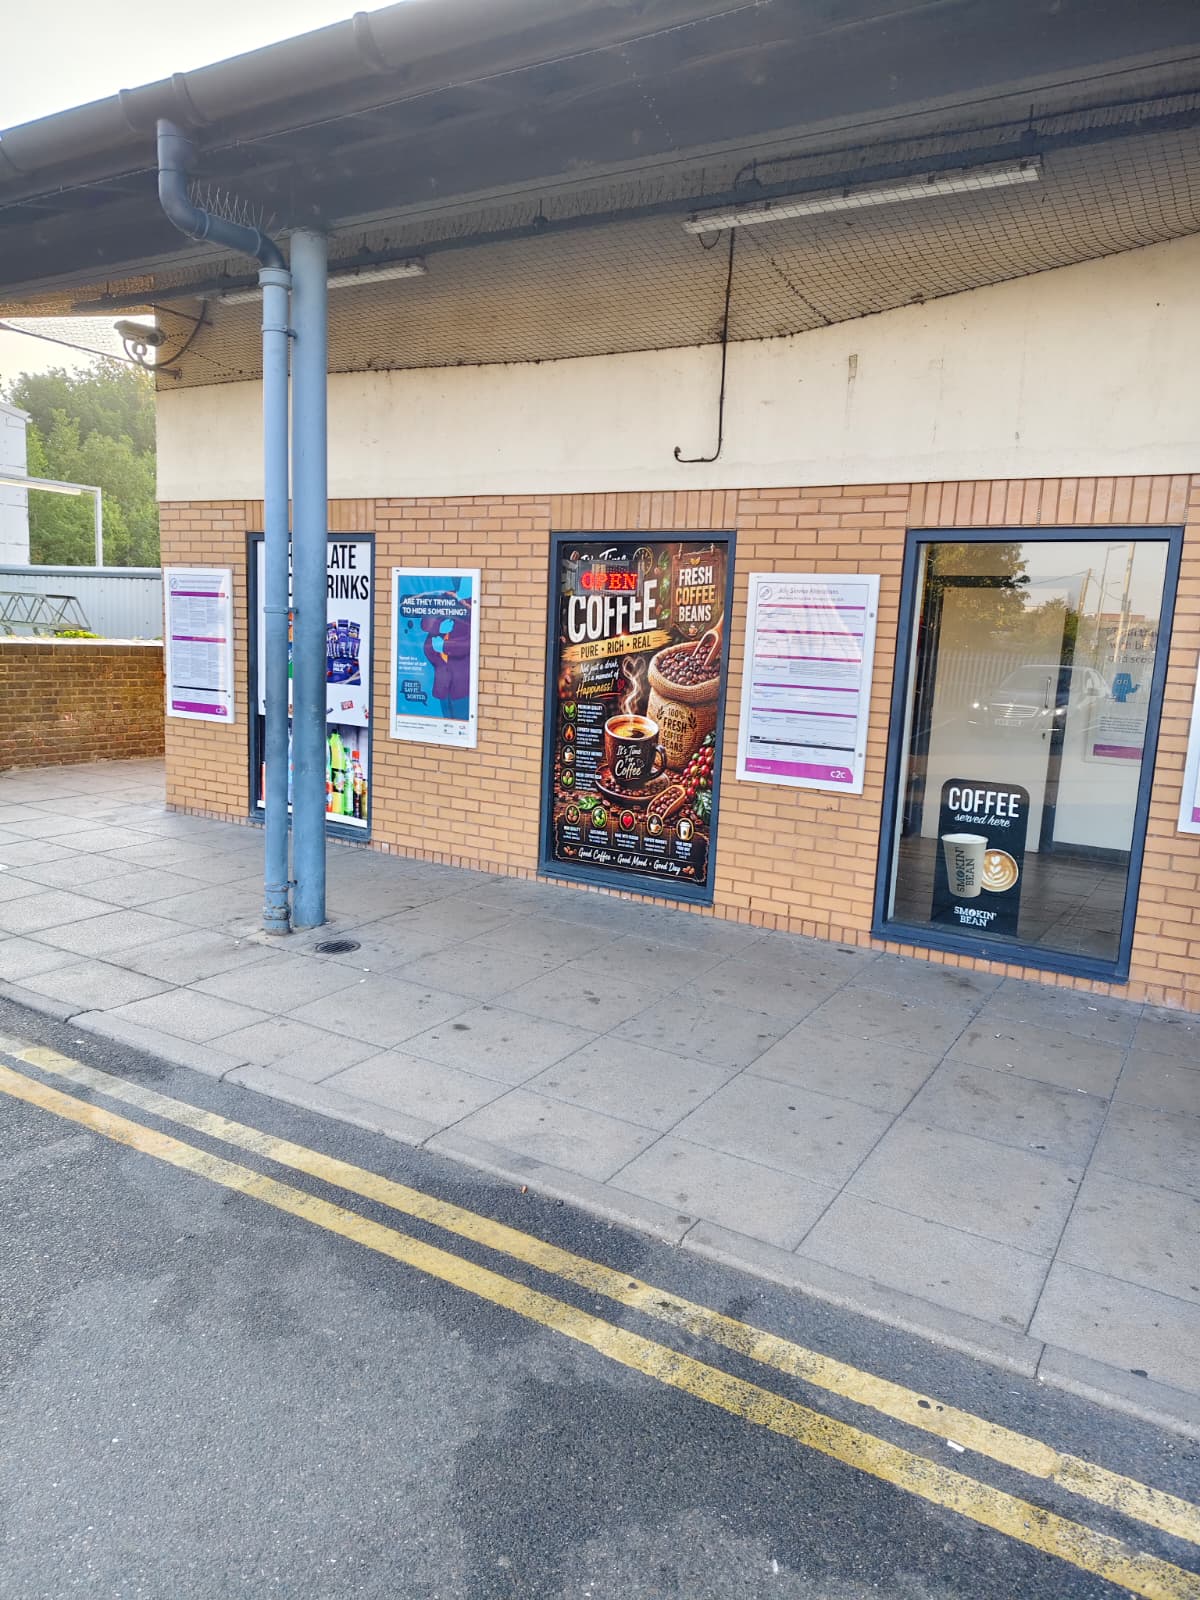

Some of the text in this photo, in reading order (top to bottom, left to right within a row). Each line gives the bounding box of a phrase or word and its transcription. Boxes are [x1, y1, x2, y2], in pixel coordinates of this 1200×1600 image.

[581, 571, 637, 590] OPEN
[679, 566, 712, 586] FRESH
[327, 575, 369, 600] RINKS
[675, 585, 715, 606] COFFEE
[416, 598, 432, 606] THEY
[434, 599, 456, 607] TRYING
[428, 608, 467, 616] SOMETHING?
[568, 579, 657, 643] COFFEE
[679, 604, 711, 622] BEANS
[580, 635, 651, 658] PURE RICH REAL
[576, 678, 615, 699] Happiness!
[663, 717, 687, 733] FRESH
[616, 744, 642, 756] It's Time
[614, 759, 642, 778] Coffee
[948, 787, 1021, 818] COFFEE
[954, 814, 1011, 828] served here
[578, 847, 681, 875] Good Coffee Good Mood Good Day
[965, 858, 975, 886] BEAN
[954, 906, 997, 921] SMOKIN'
[959, 914, 987, 927] BEAN
